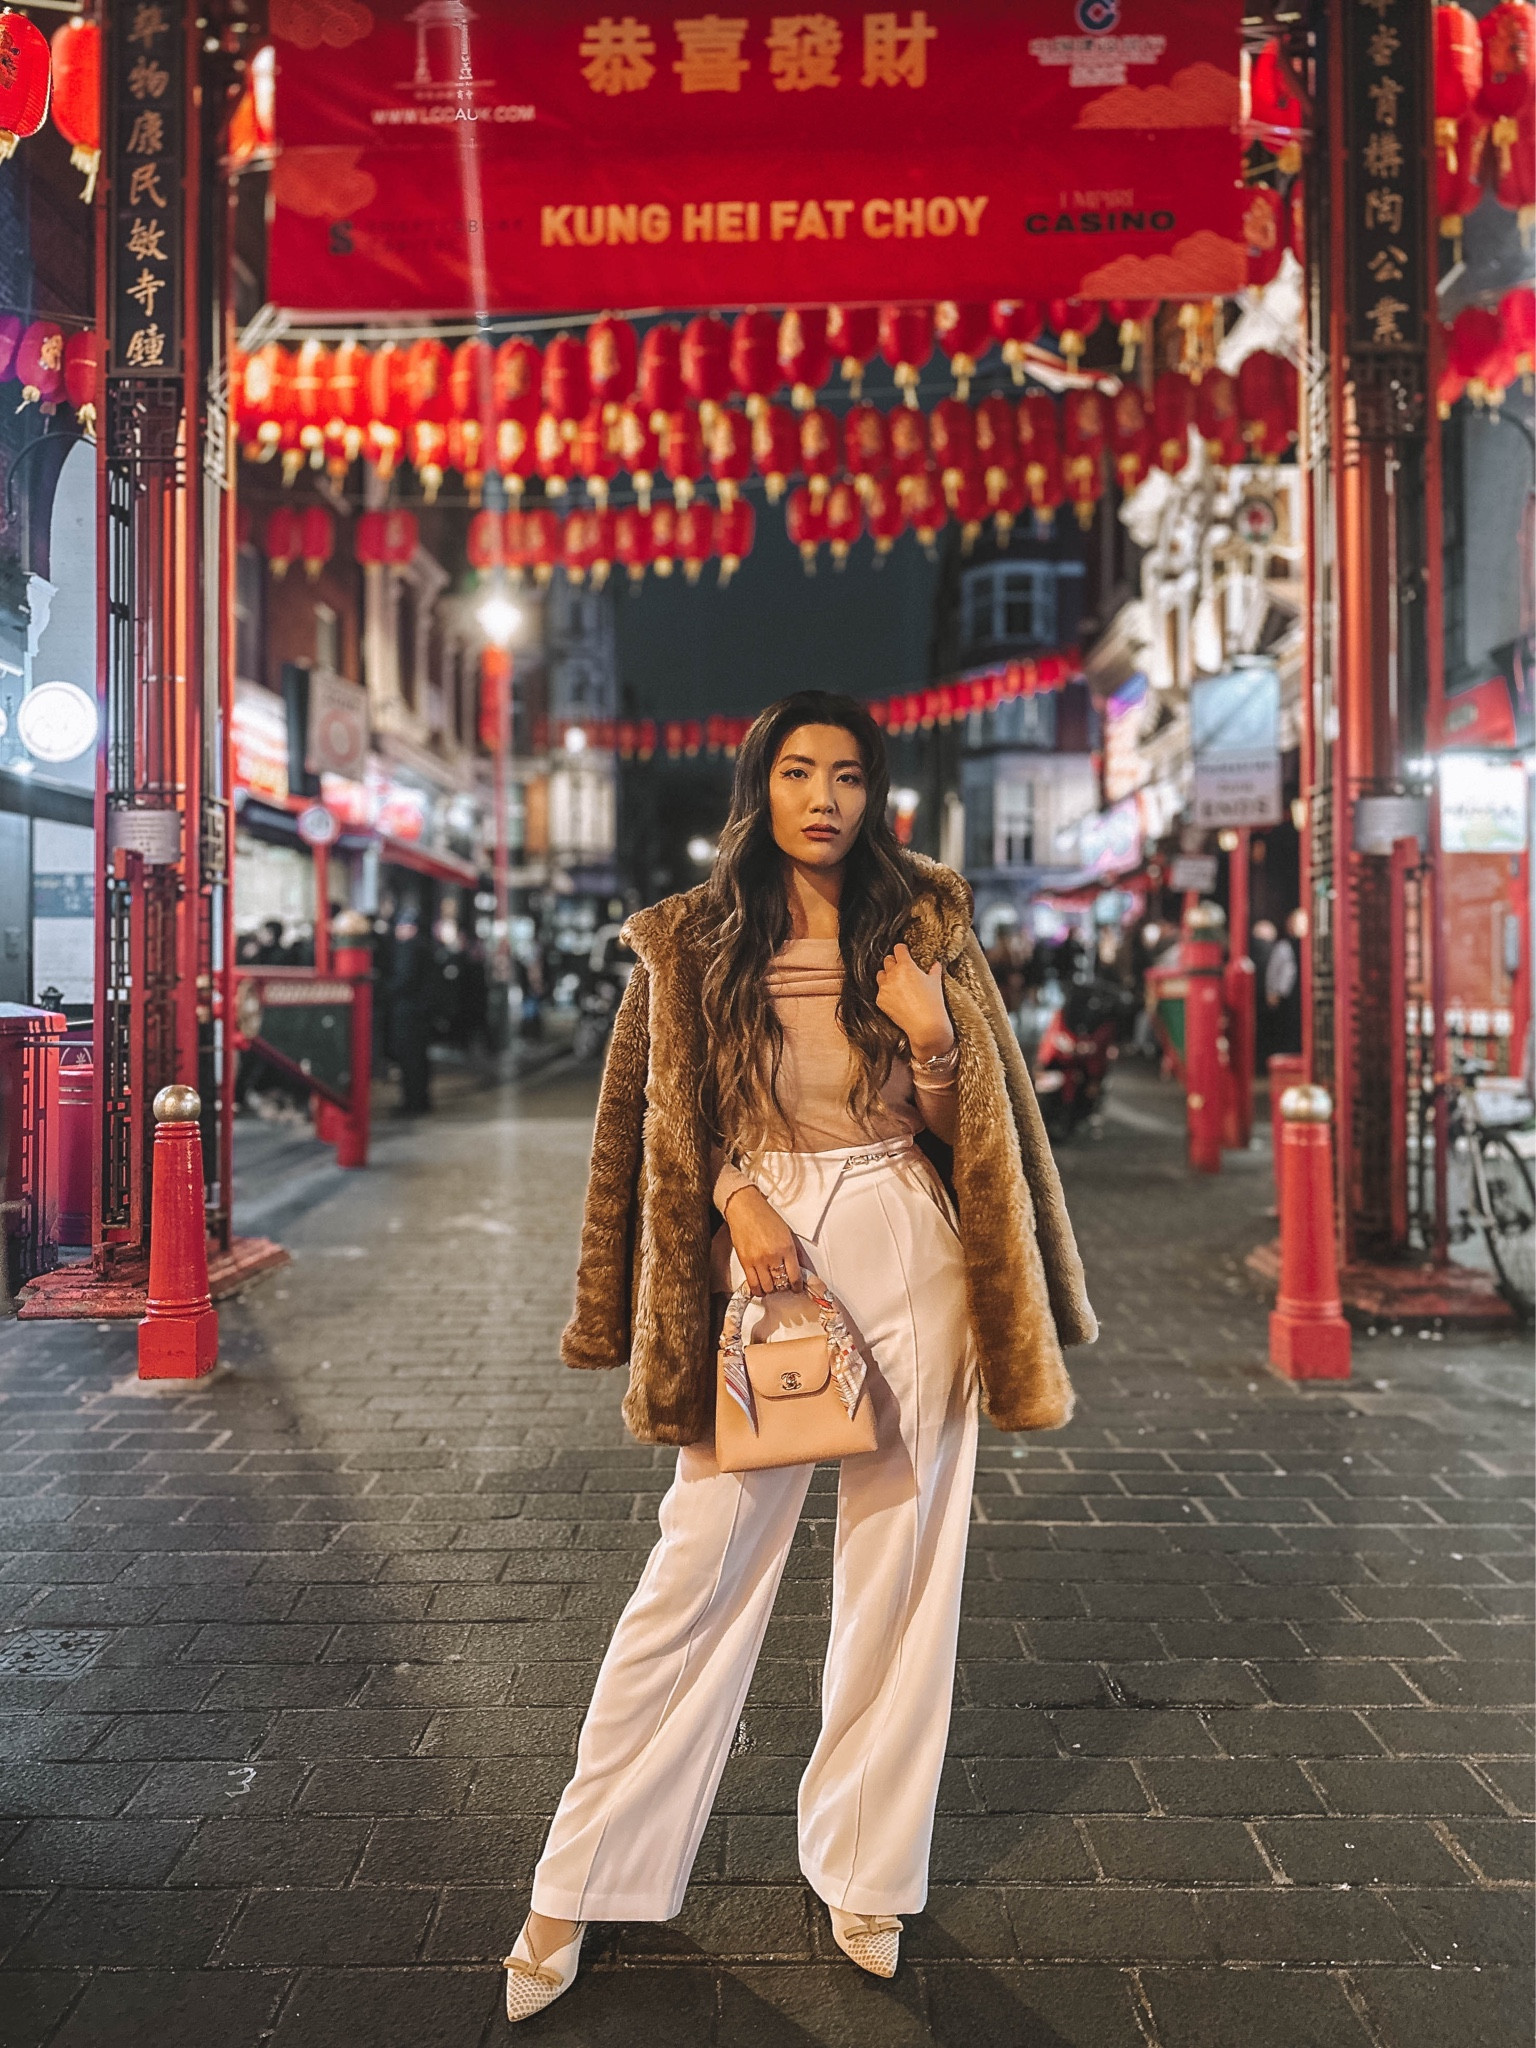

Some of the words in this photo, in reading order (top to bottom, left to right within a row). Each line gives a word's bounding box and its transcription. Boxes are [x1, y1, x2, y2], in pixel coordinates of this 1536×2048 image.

[580, 10, 938, 95] 恭喜發財
[541, 205, 671, 246] KUNG
[683, 203, 761, 243] HEI
[771, 200, 854, 241] FAT
[863, 197, 988, 238] CHOY
[1025, 211, 1176, 234] CASINO
